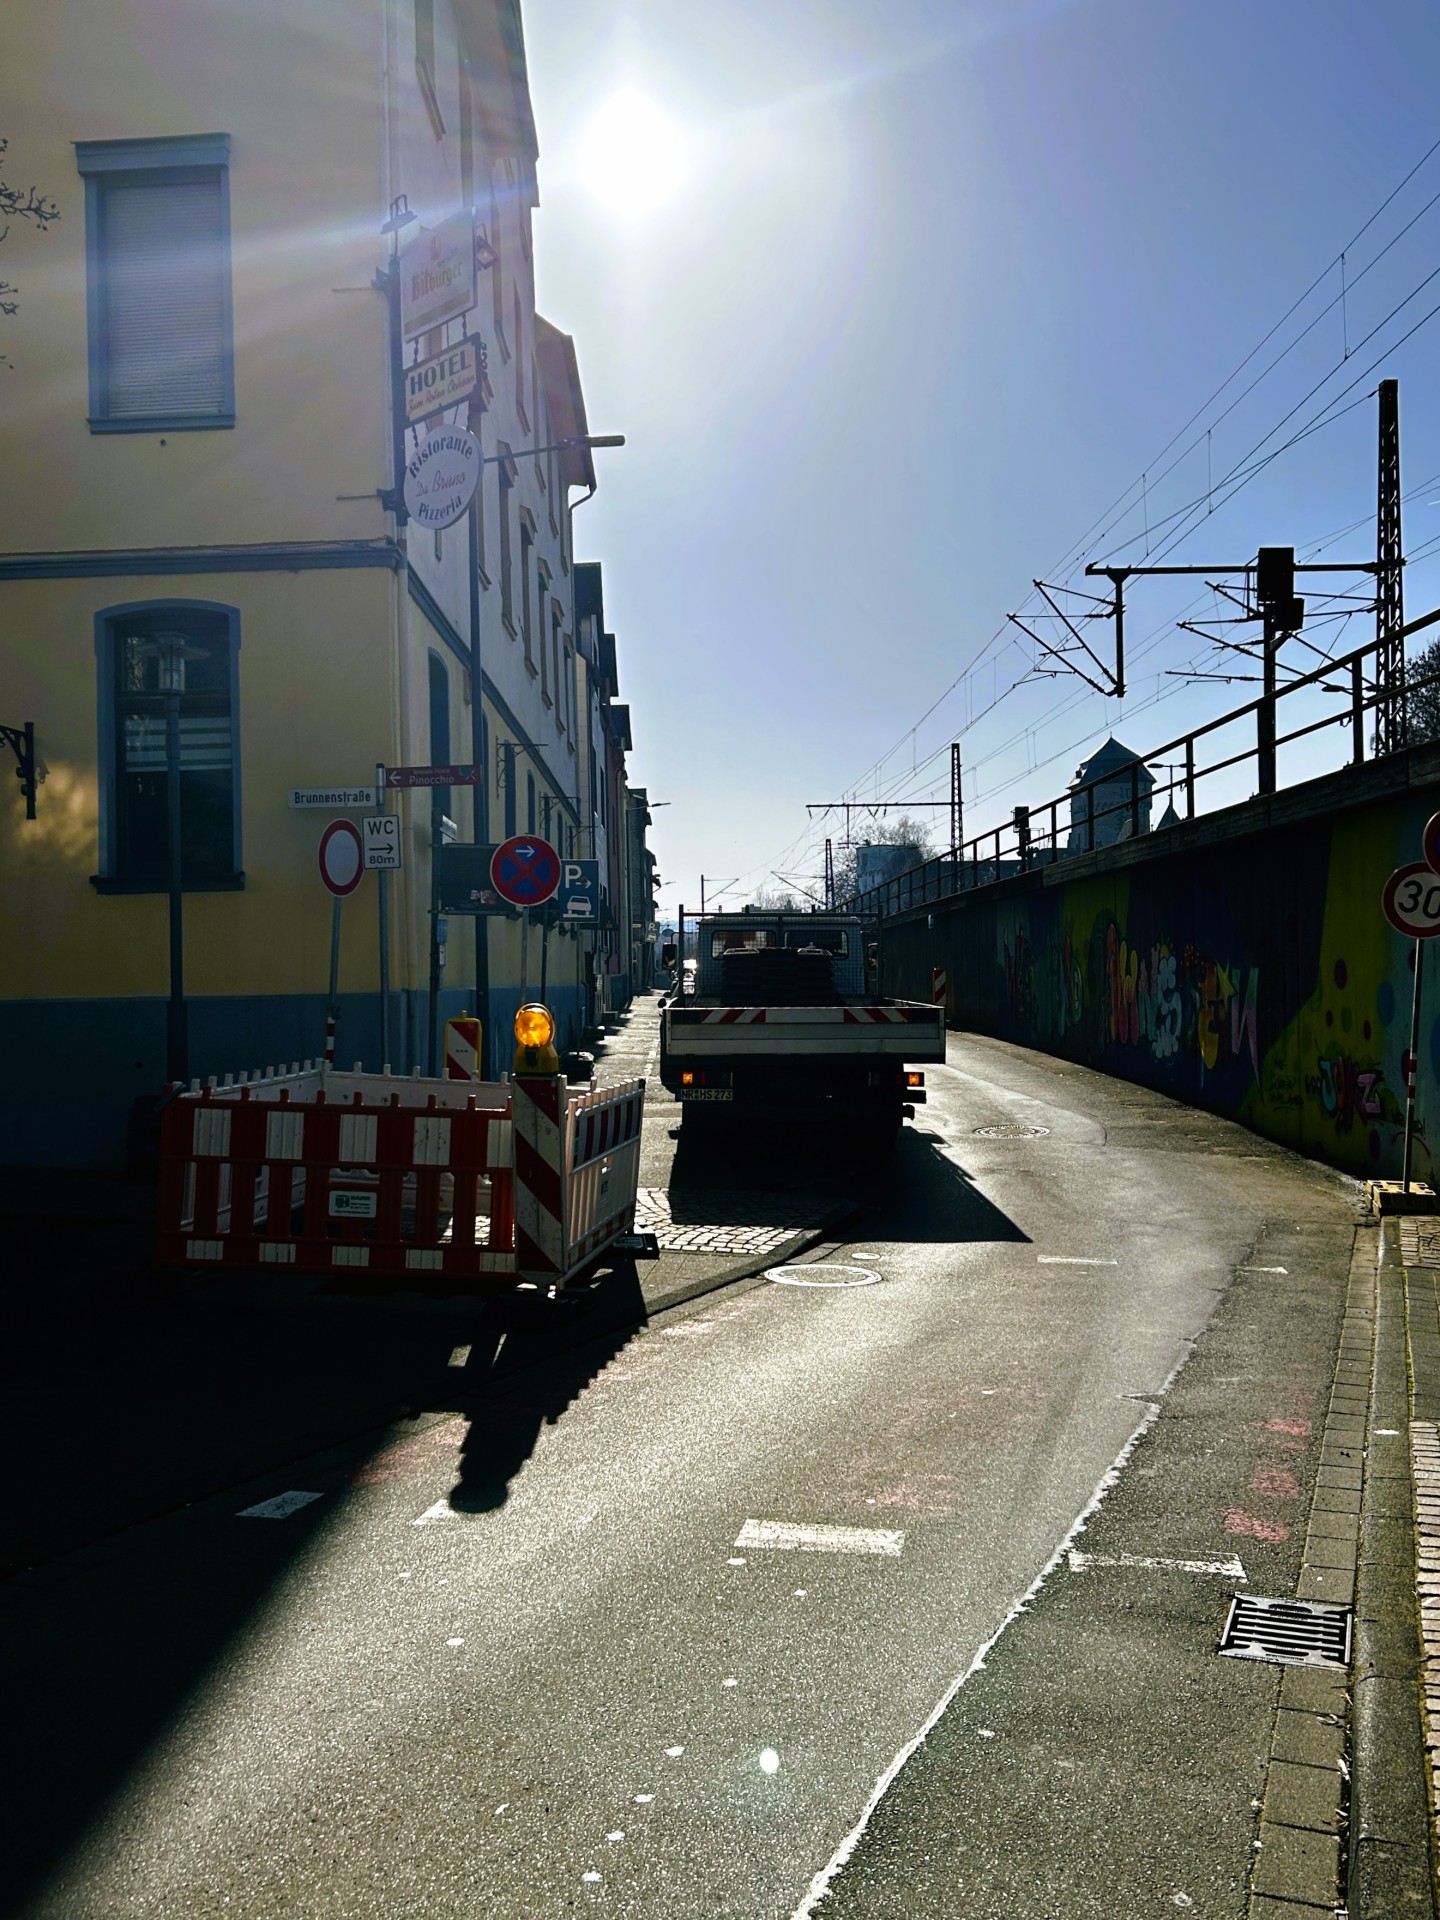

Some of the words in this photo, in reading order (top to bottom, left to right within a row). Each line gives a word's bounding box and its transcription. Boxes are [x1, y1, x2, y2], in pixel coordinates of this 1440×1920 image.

[411, 261, 463, 302] Bitburger
[410, 350, 473, 396] HOTEL
[425, 388, 446, 405] Roten
[409, 435, 474, 480] Ristorante
[432, 469, 466, 493] Bruno
[418, 495, 463, 521] Pizzeria
[409, 774, 455, 786] Pinocchio
[294, 791, 372, 805] Brunnenstraße
[368, 820, 394, 836] WC
[369, 855, 395, 865] 80m
[565, 865, 582, 888] P
[1398, 880, 1440, 919] 30
[682, 1090, 694, 1099] NR
[700, 1090, 713, 1099] HS
[714, 1090, 732, 1099] 273
